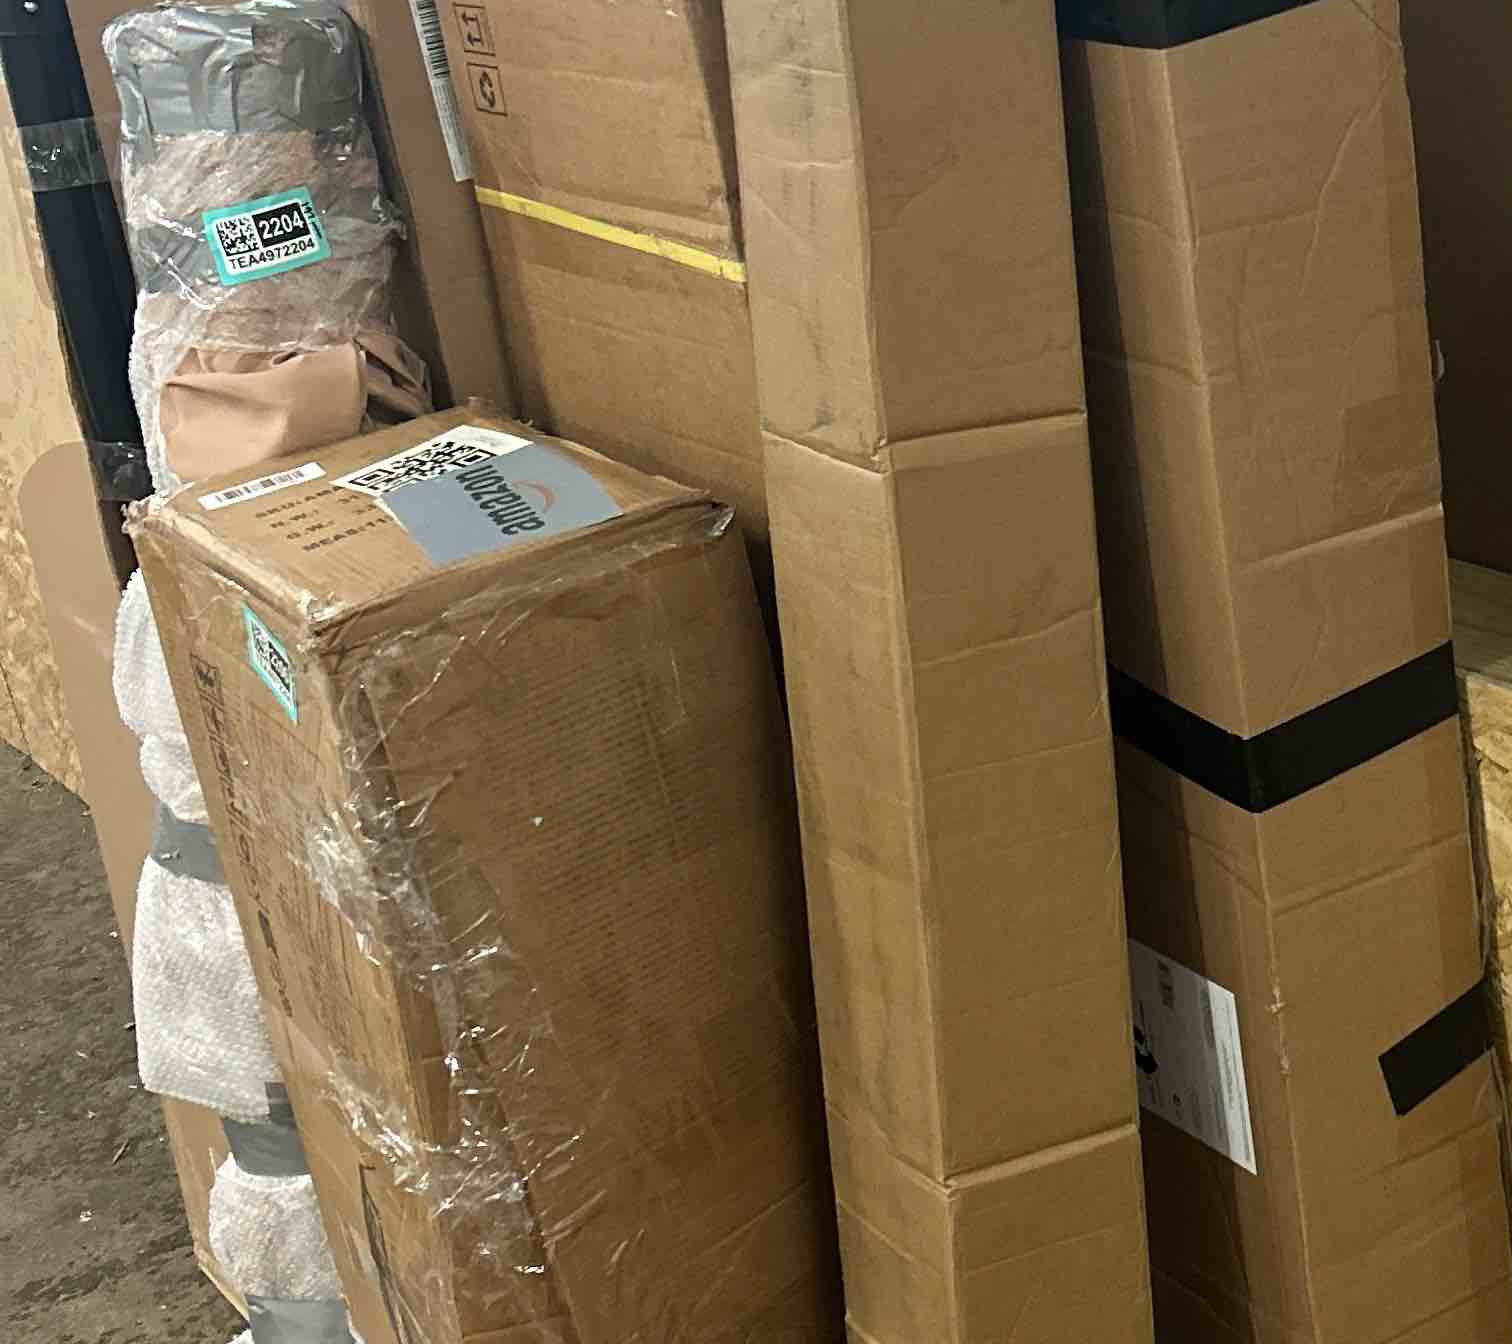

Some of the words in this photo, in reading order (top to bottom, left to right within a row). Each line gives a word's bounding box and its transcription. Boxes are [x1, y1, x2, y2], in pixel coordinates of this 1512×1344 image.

[258, 210, 305, 240] 2204
[229, 237, 316, 270] TEA4972204
[455, 462, 547, 536] amazon
